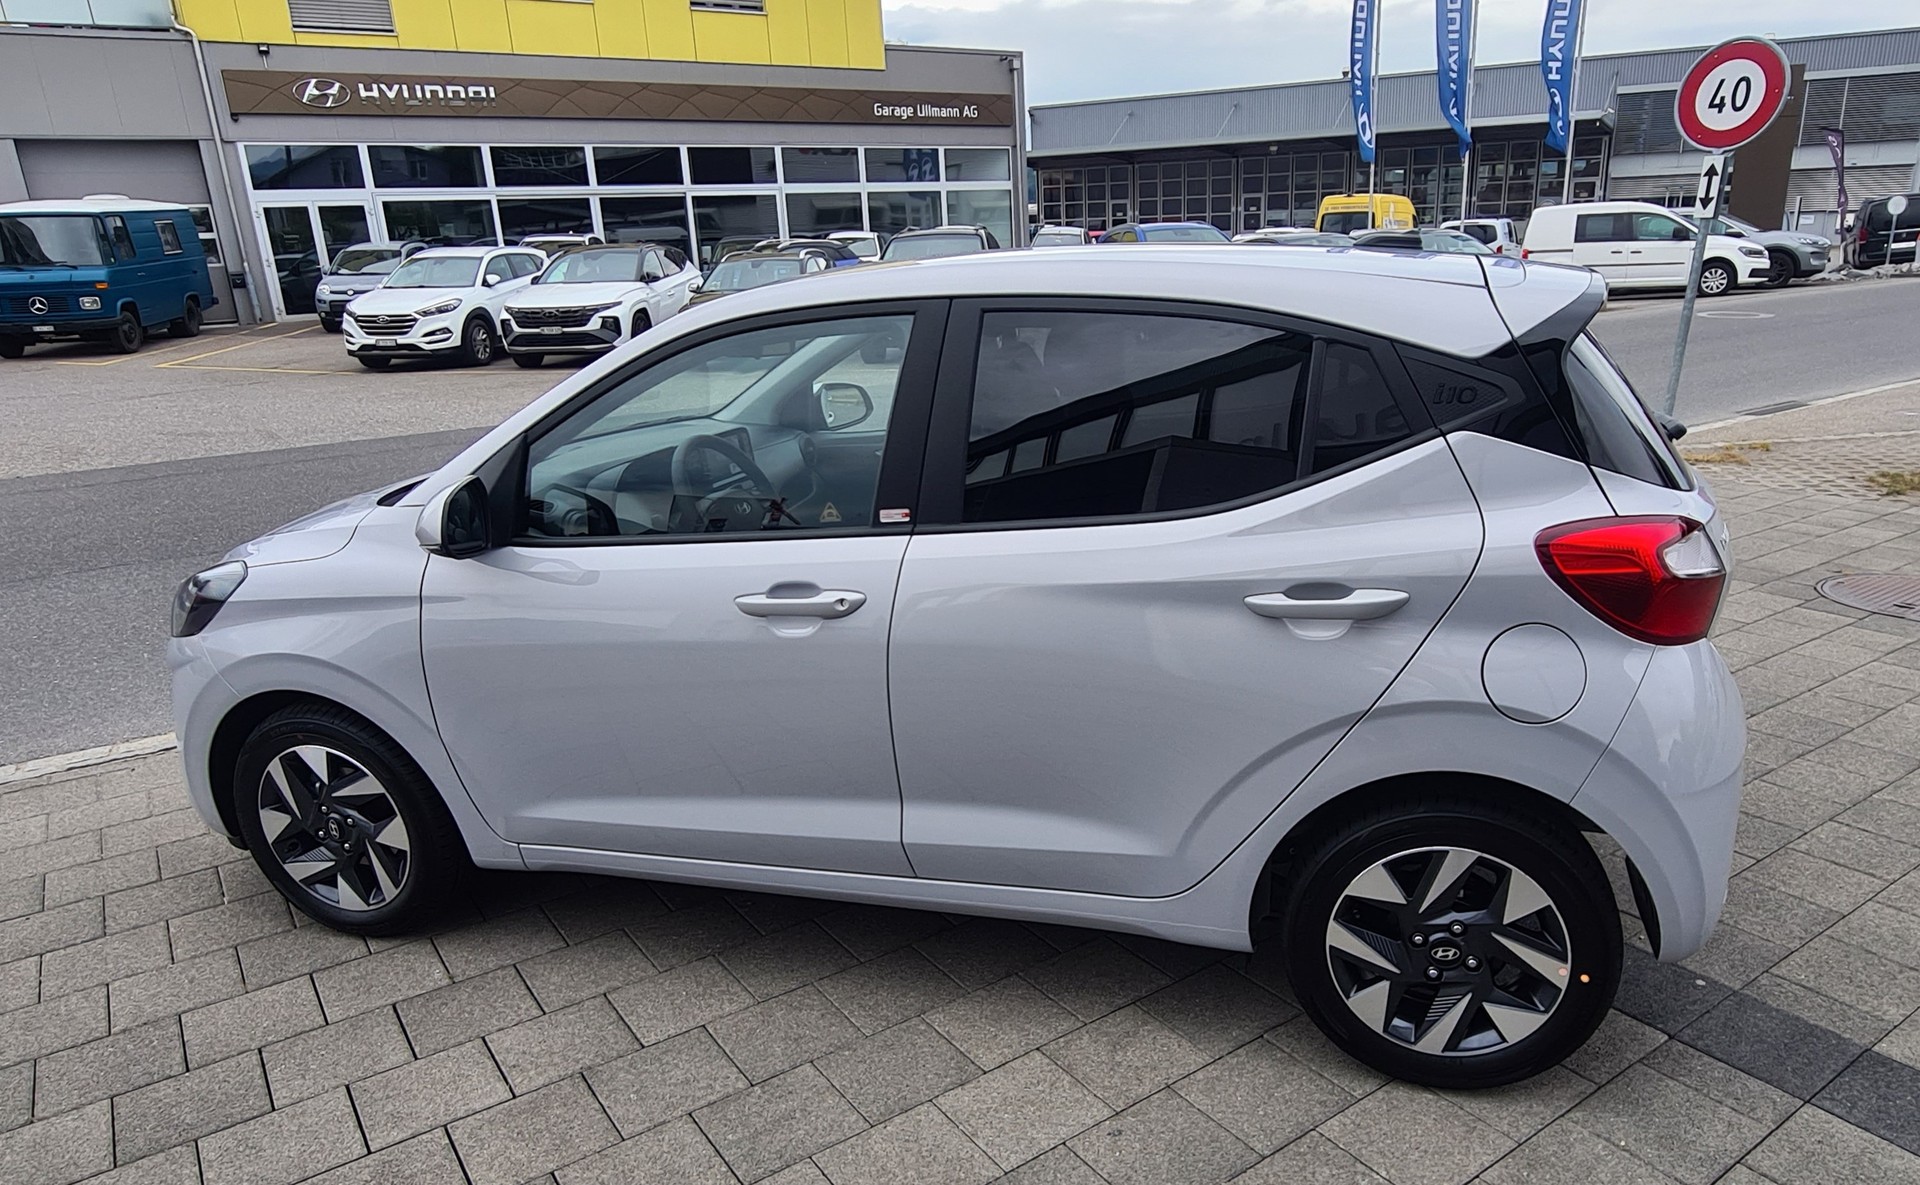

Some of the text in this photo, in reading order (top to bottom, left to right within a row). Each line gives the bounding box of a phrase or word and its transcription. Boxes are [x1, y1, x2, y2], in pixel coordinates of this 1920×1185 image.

[357, 82, 497, 107] HYUNDAI
[1708, 76, 1751, 114] 40
[873, 103, 978, 119] Garage Ullmann AG
[1433, 383, 1478, 404] i10
